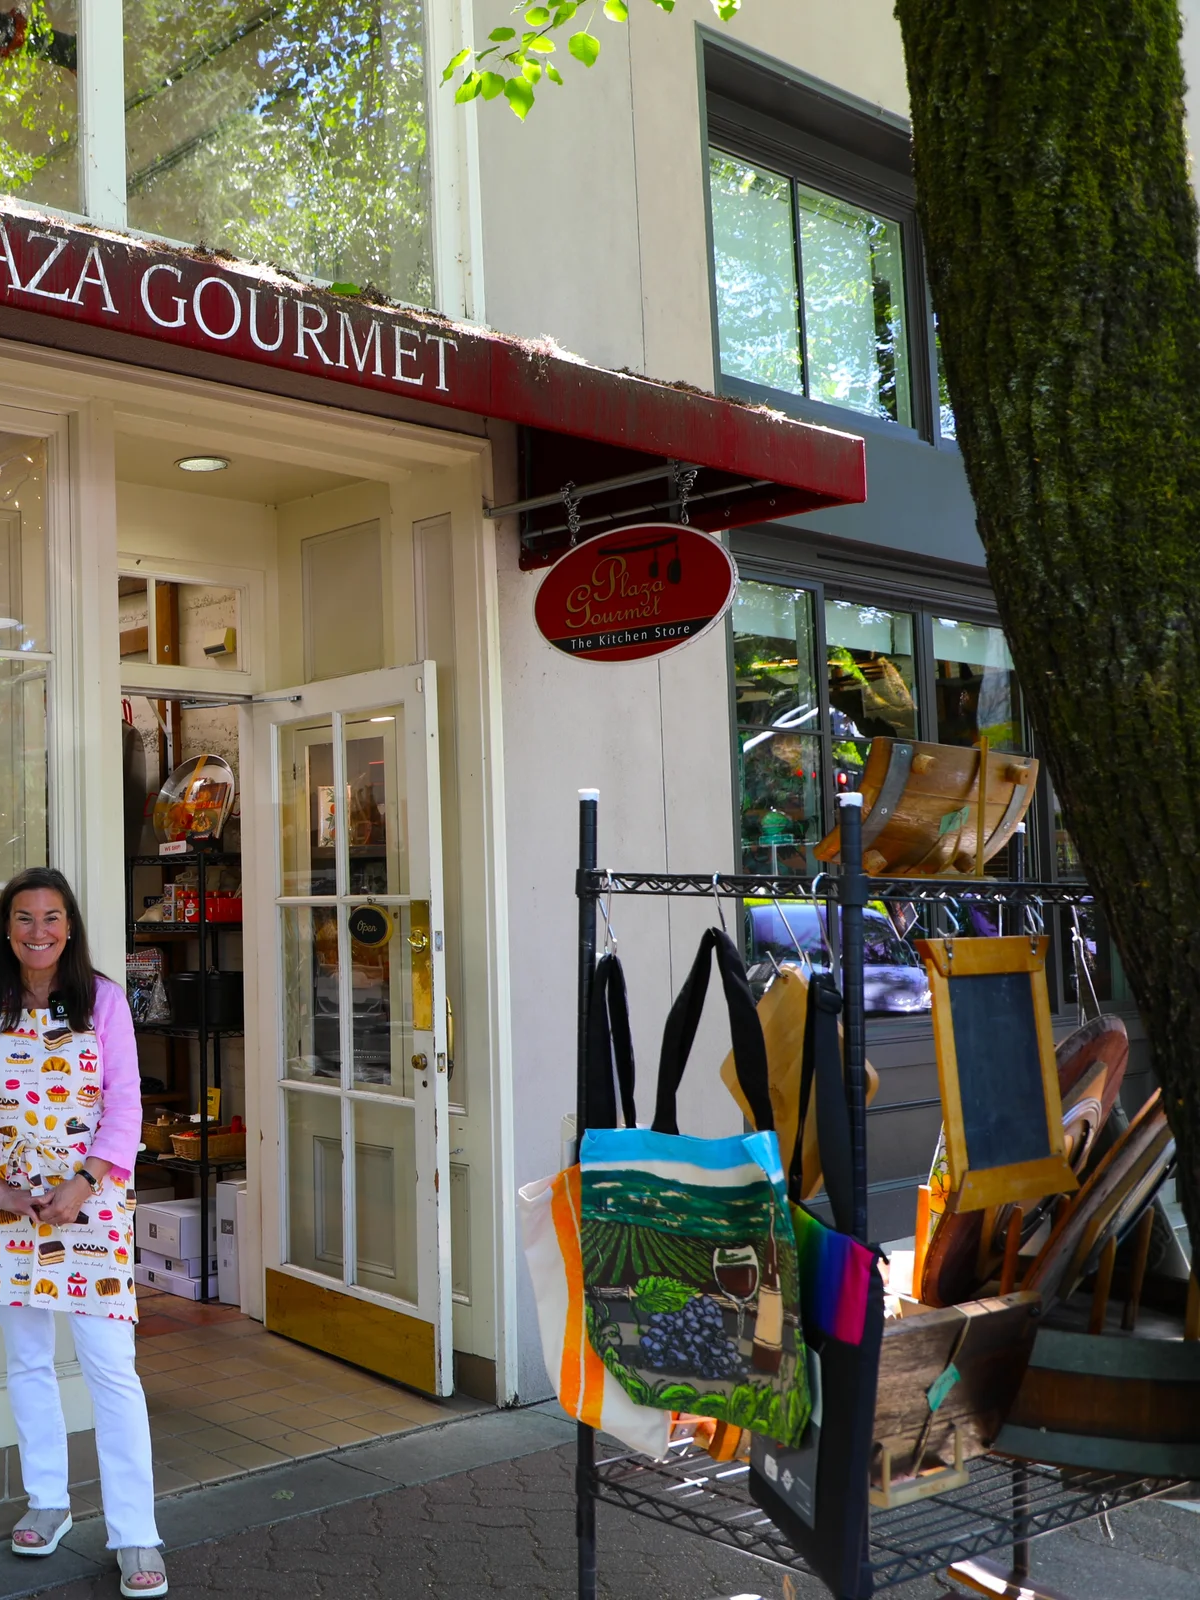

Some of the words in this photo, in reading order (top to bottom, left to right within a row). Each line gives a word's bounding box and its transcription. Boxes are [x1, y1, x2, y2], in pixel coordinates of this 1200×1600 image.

[140, 263, 458, 392] GOURMET
[591, 555, 665, 605] Plaza
[565, 584, 662, 629] Gourmet
[571, 639, 592, 650] The
[599, 631, 648, 646] Kitchen
[655, 624, 690, 637] Store
[357, 919, 377, 935] Open
